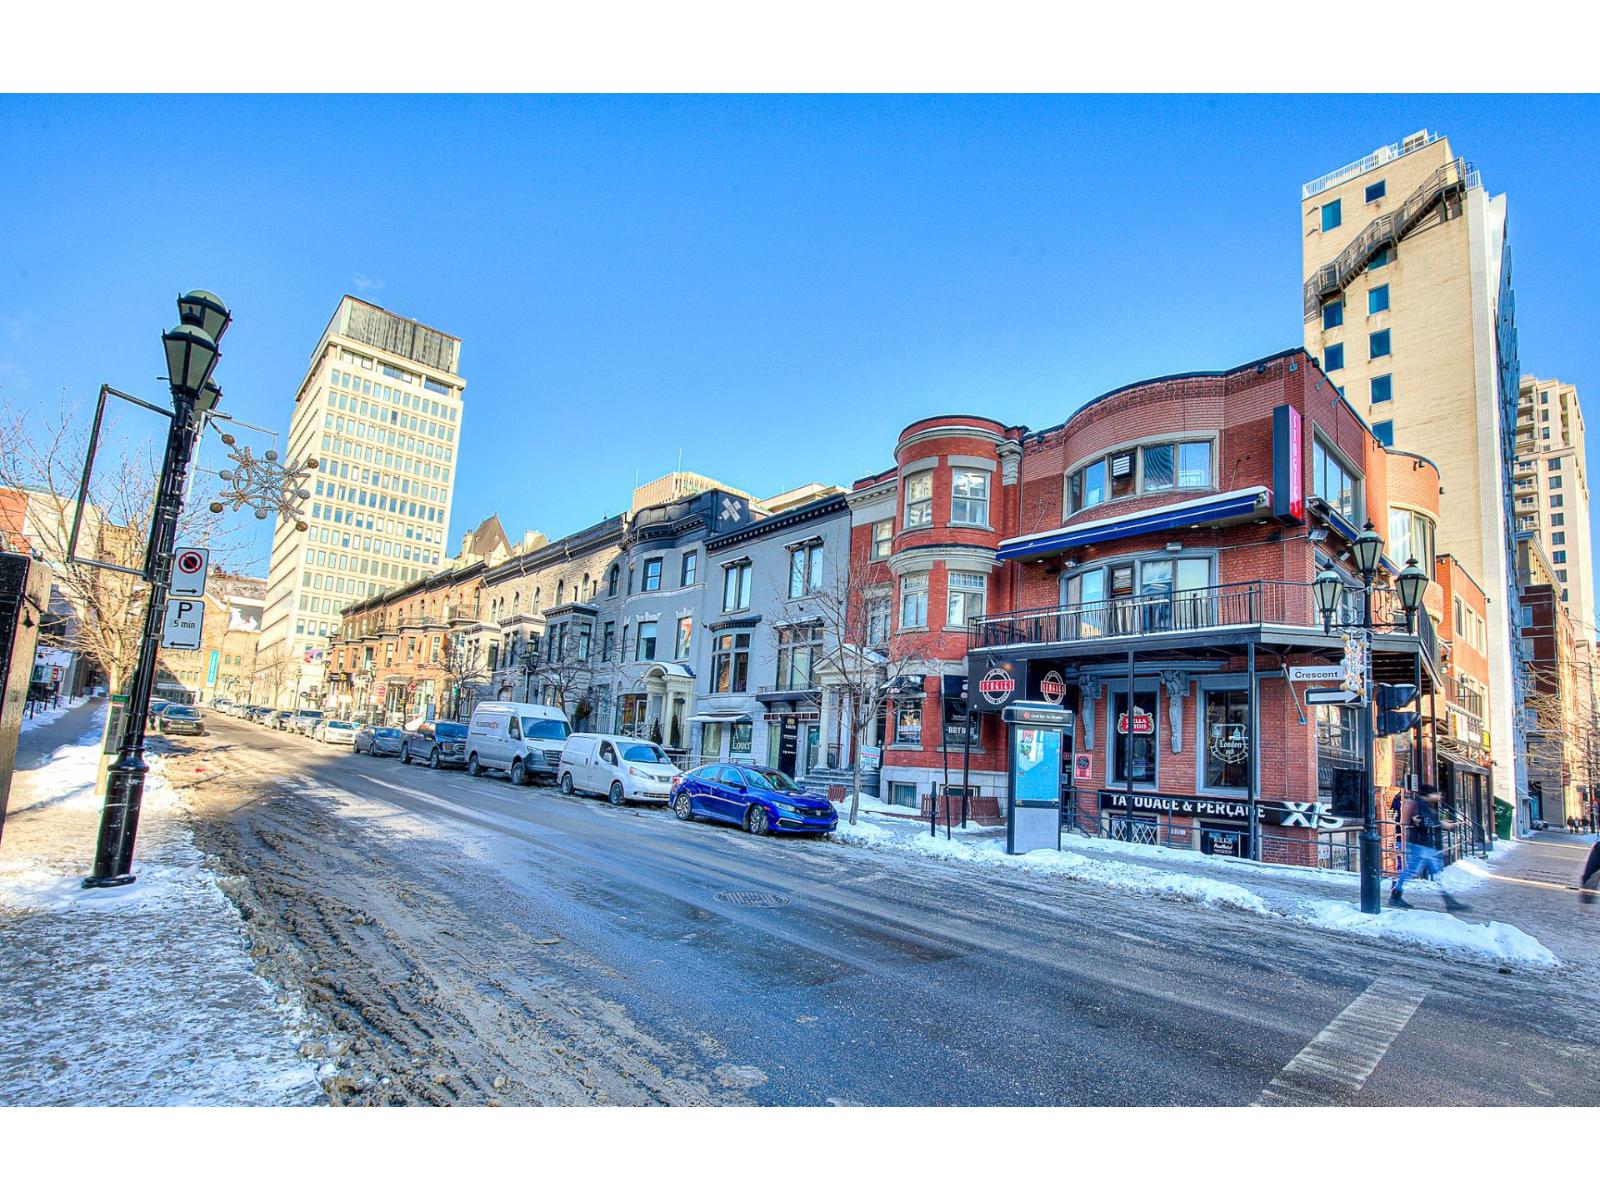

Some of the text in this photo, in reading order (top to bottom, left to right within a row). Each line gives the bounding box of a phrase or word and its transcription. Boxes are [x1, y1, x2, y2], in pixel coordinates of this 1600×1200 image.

[178, 601, 193, 619] P
[1295, 671, 1338, 679] Crescent
[1110, 794, 1180, 811] TAOUAGE
[1182, 801, 1193, 812] &
